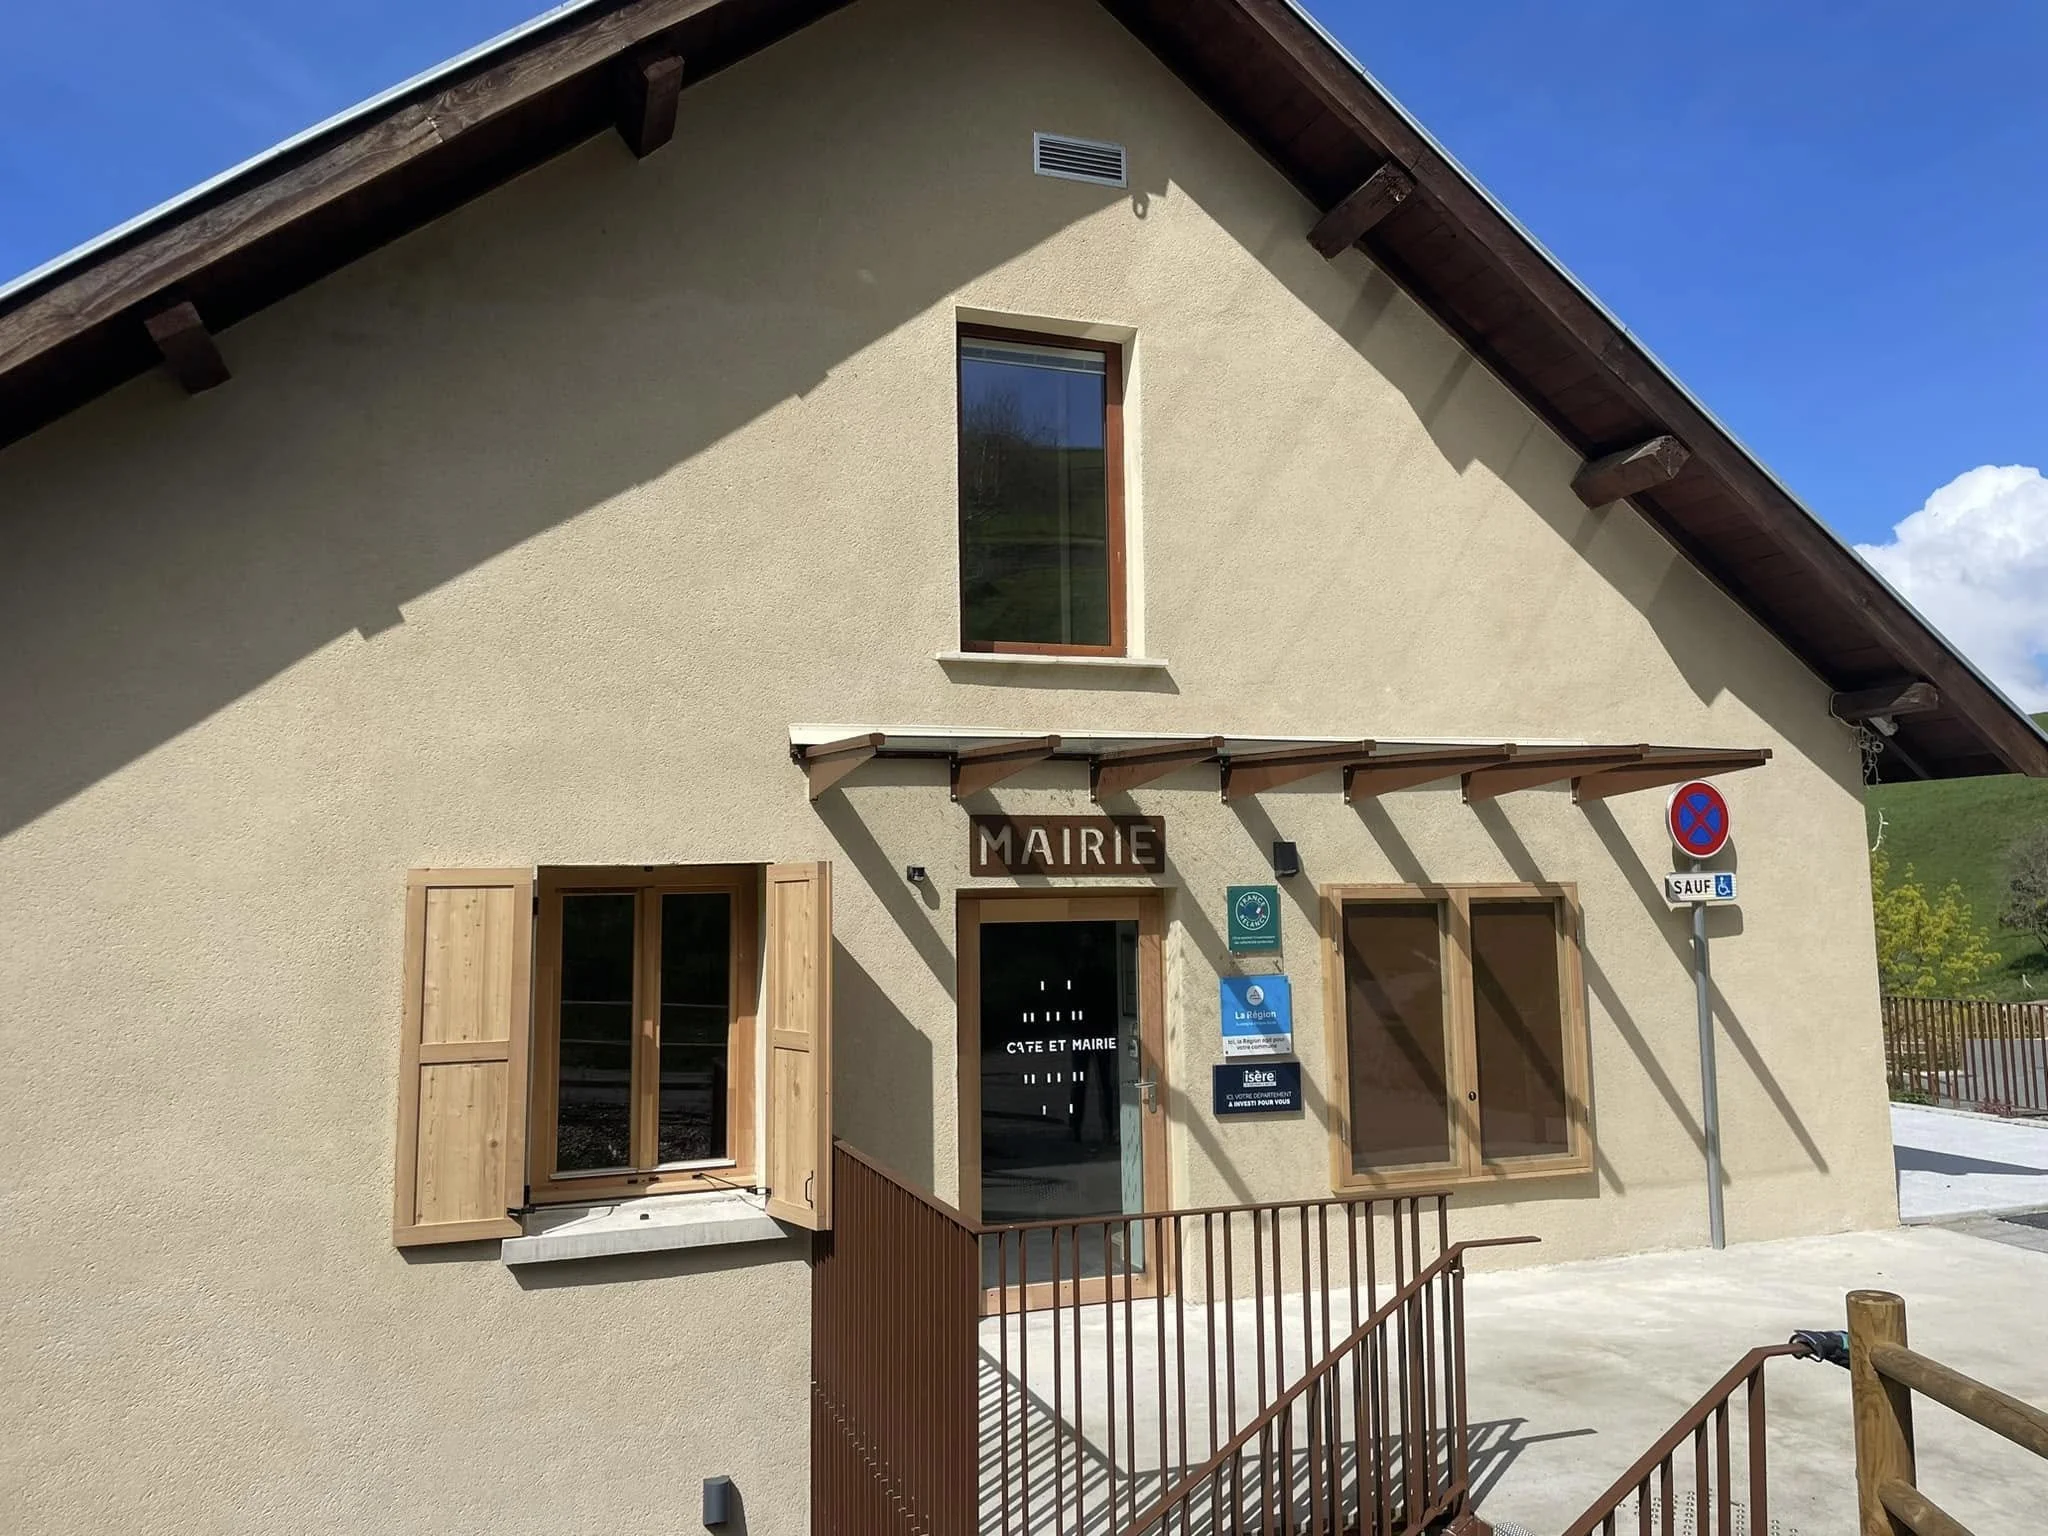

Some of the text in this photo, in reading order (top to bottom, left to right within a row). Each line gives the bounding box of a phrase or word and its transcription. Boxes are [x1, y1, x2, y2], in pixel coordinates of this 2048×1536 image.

[978, 824, 1156, 866] MAIRIE
[1674, 879, 1711, 894] SAUF
[1235, 1010, 1277, 1020] La Région
[1049, 1039, 1067, 1052] ET
[1072, 1037, 1117, 1051] MAIRIE
[1244, 1070, 1274, 1082] isère
